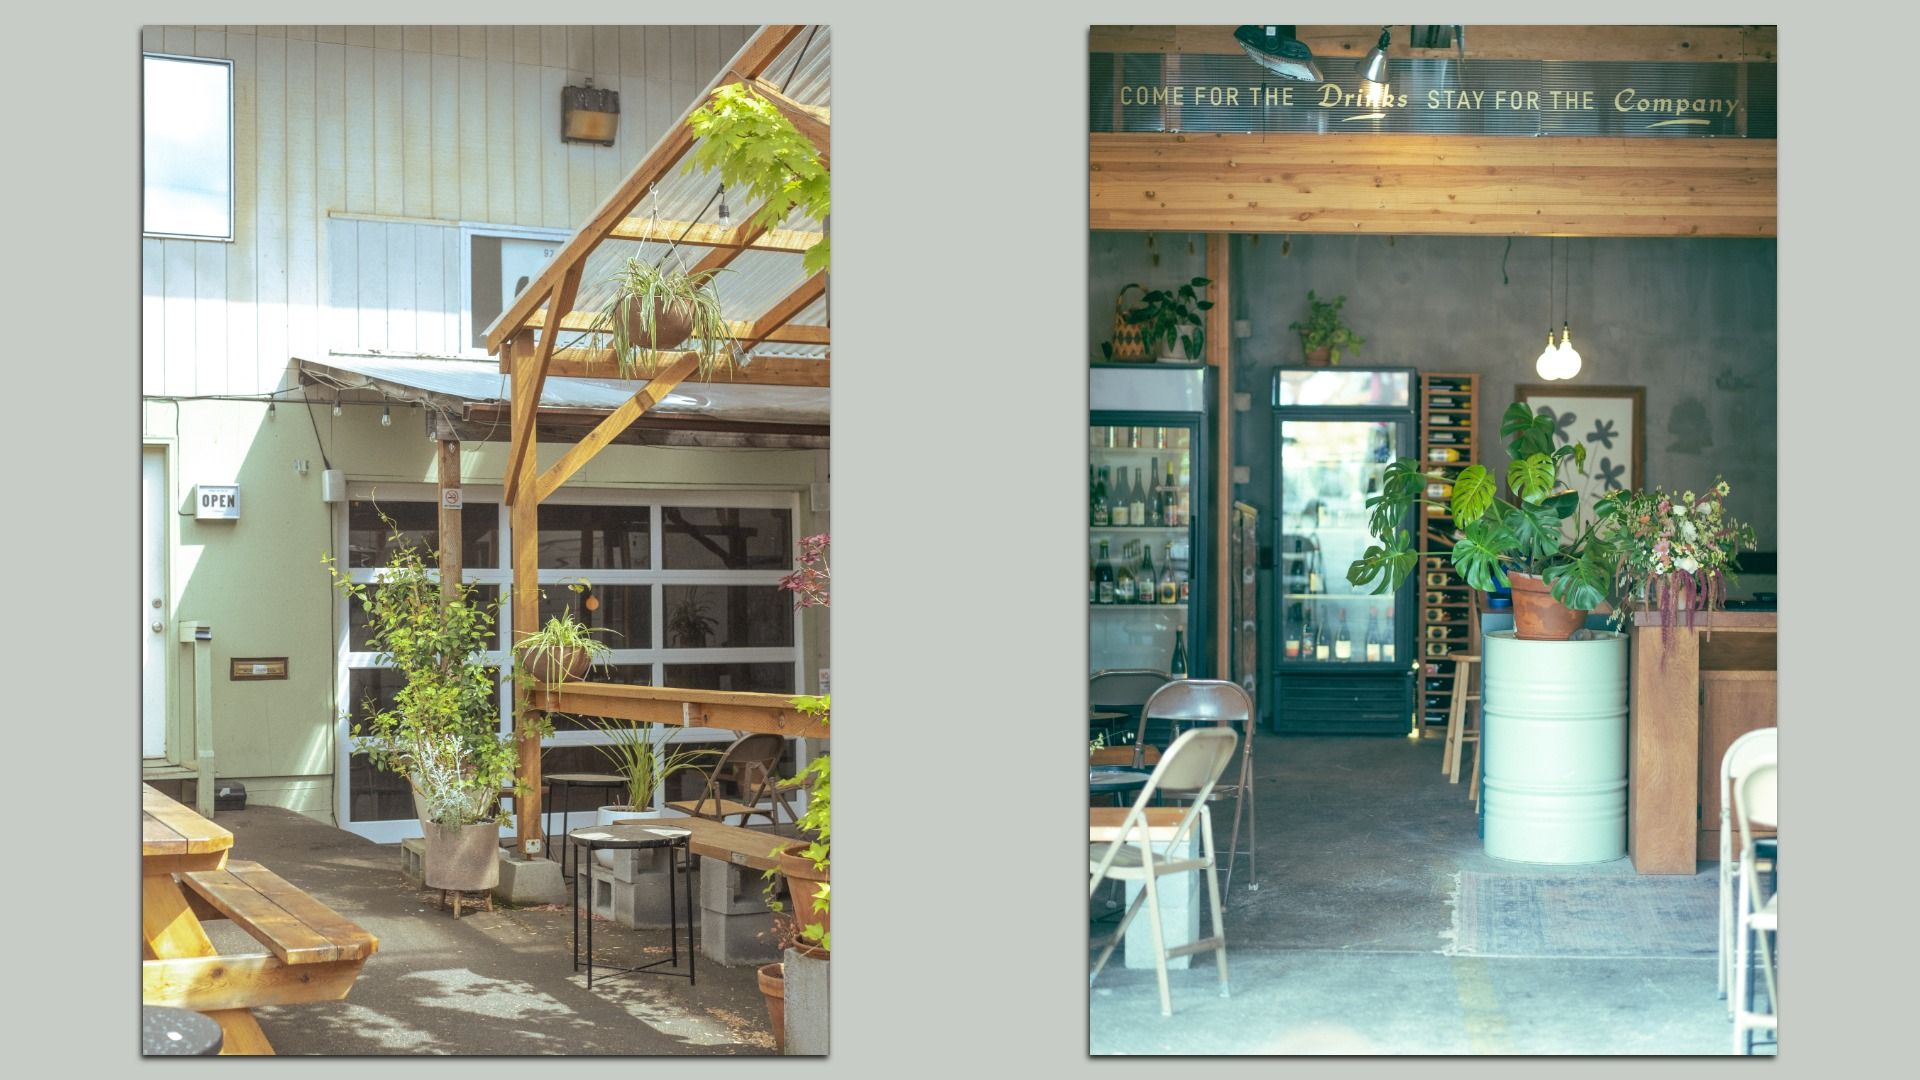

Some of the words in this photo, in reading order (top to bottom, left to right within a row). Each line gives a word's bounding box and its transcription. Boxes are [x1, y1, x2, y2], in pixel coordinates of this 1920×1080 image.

[1121, 86, 1184, 105] COME
[1195, 86, 1239, 106] FOR
[1249, 87, 1294, 106] THE
[1316, 83, 1408, 108] Drinks
[1427, 89, 1485, 110] STAY
[1495, 90, 1539, 110] FOR
[1549, 91, 1594, 110] THE
[202, 494, 235, 508] OPEN
